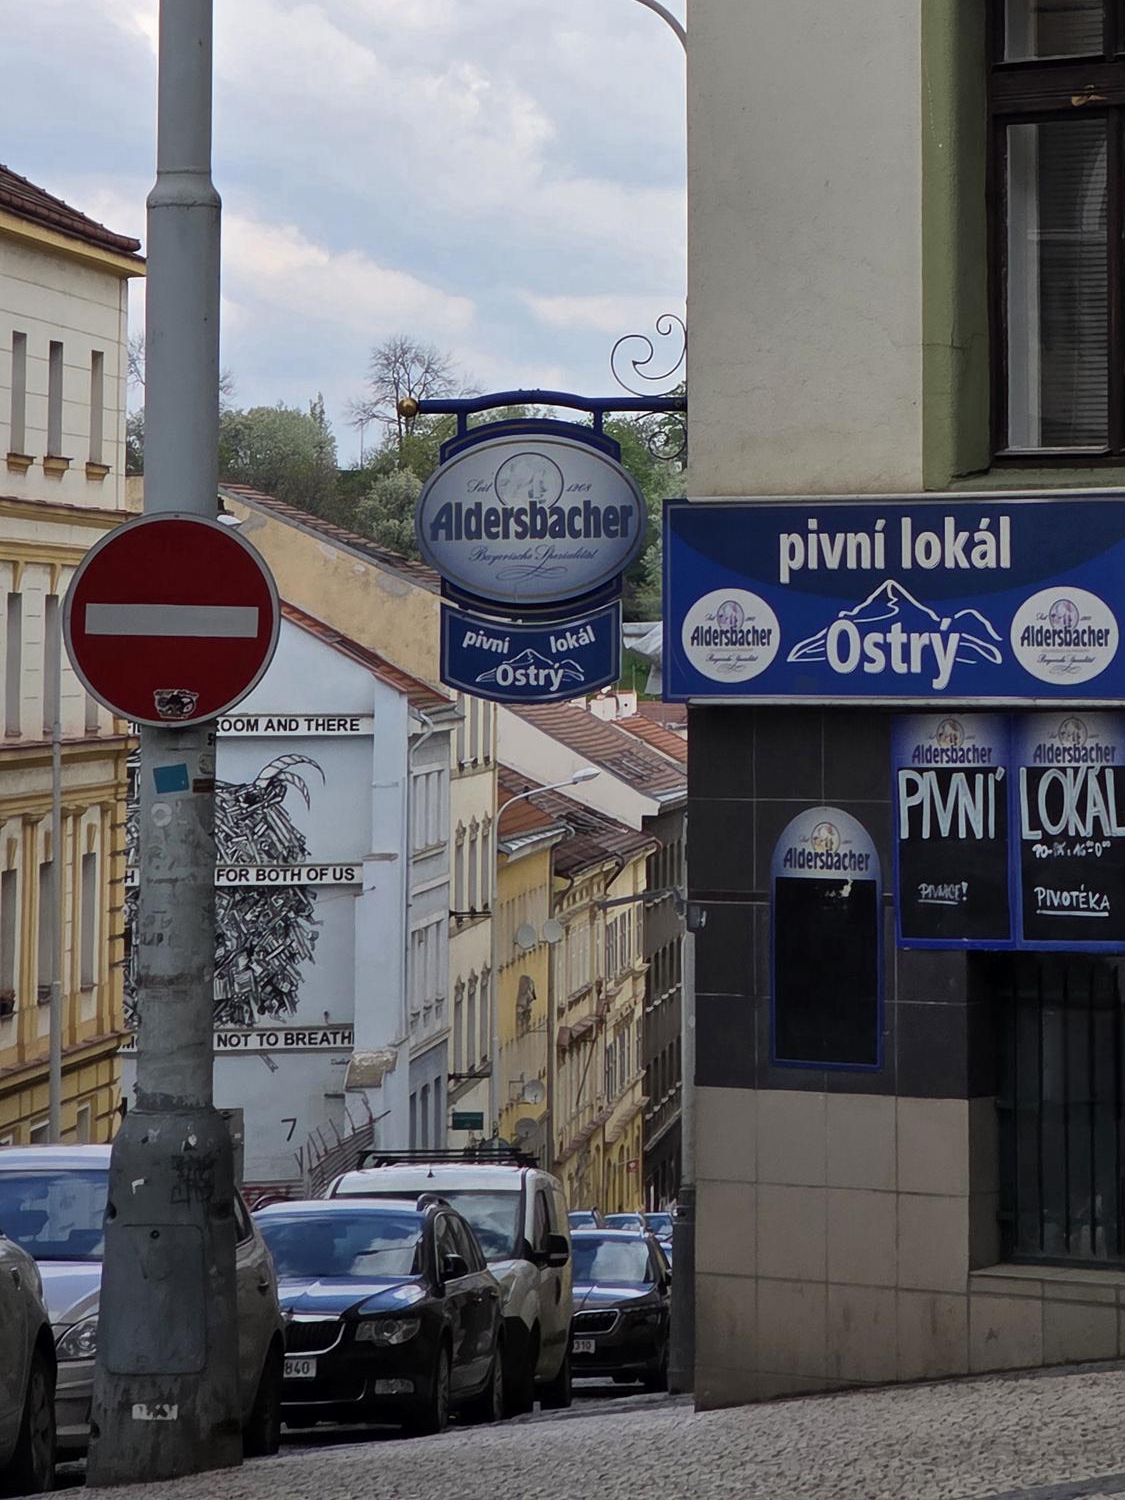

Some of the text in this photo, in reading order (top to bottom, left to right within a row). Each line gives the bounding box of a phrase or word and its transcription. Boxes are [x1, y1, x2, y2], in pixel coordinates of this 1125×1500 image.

[429, 500, 633, 541] Aldersbacher
[779, 516, 1010, 583] pivní lokál
[462, 625, 596, 654] pivní lokál
[690, 626, 772, 646] Aldersbacher
[1021, 625, 1109, 647] Aldersbacher
[826, 618, 960, 690] Ostrý
[496, 661, 564, 691] Ostrý
[264, 718, 299, 733] AND
[304, 717, 360, 732] THERE
[912, 744, 993, 764] Aldersbacher
[1033, 743, 1116, 763] Aldersbacher
[898, 766, 1005, 840] PIVNÍ
[783, 848, 870, 871] Aldersbacher
[217, 866, 355, 883] FOR BOTH OF US
[1033, 884, 1110, 910] PIVOTÉKA
[217, 1029, 354, 1047] NOT TO BREATH
[281, 1118, 297, 1142] 7
